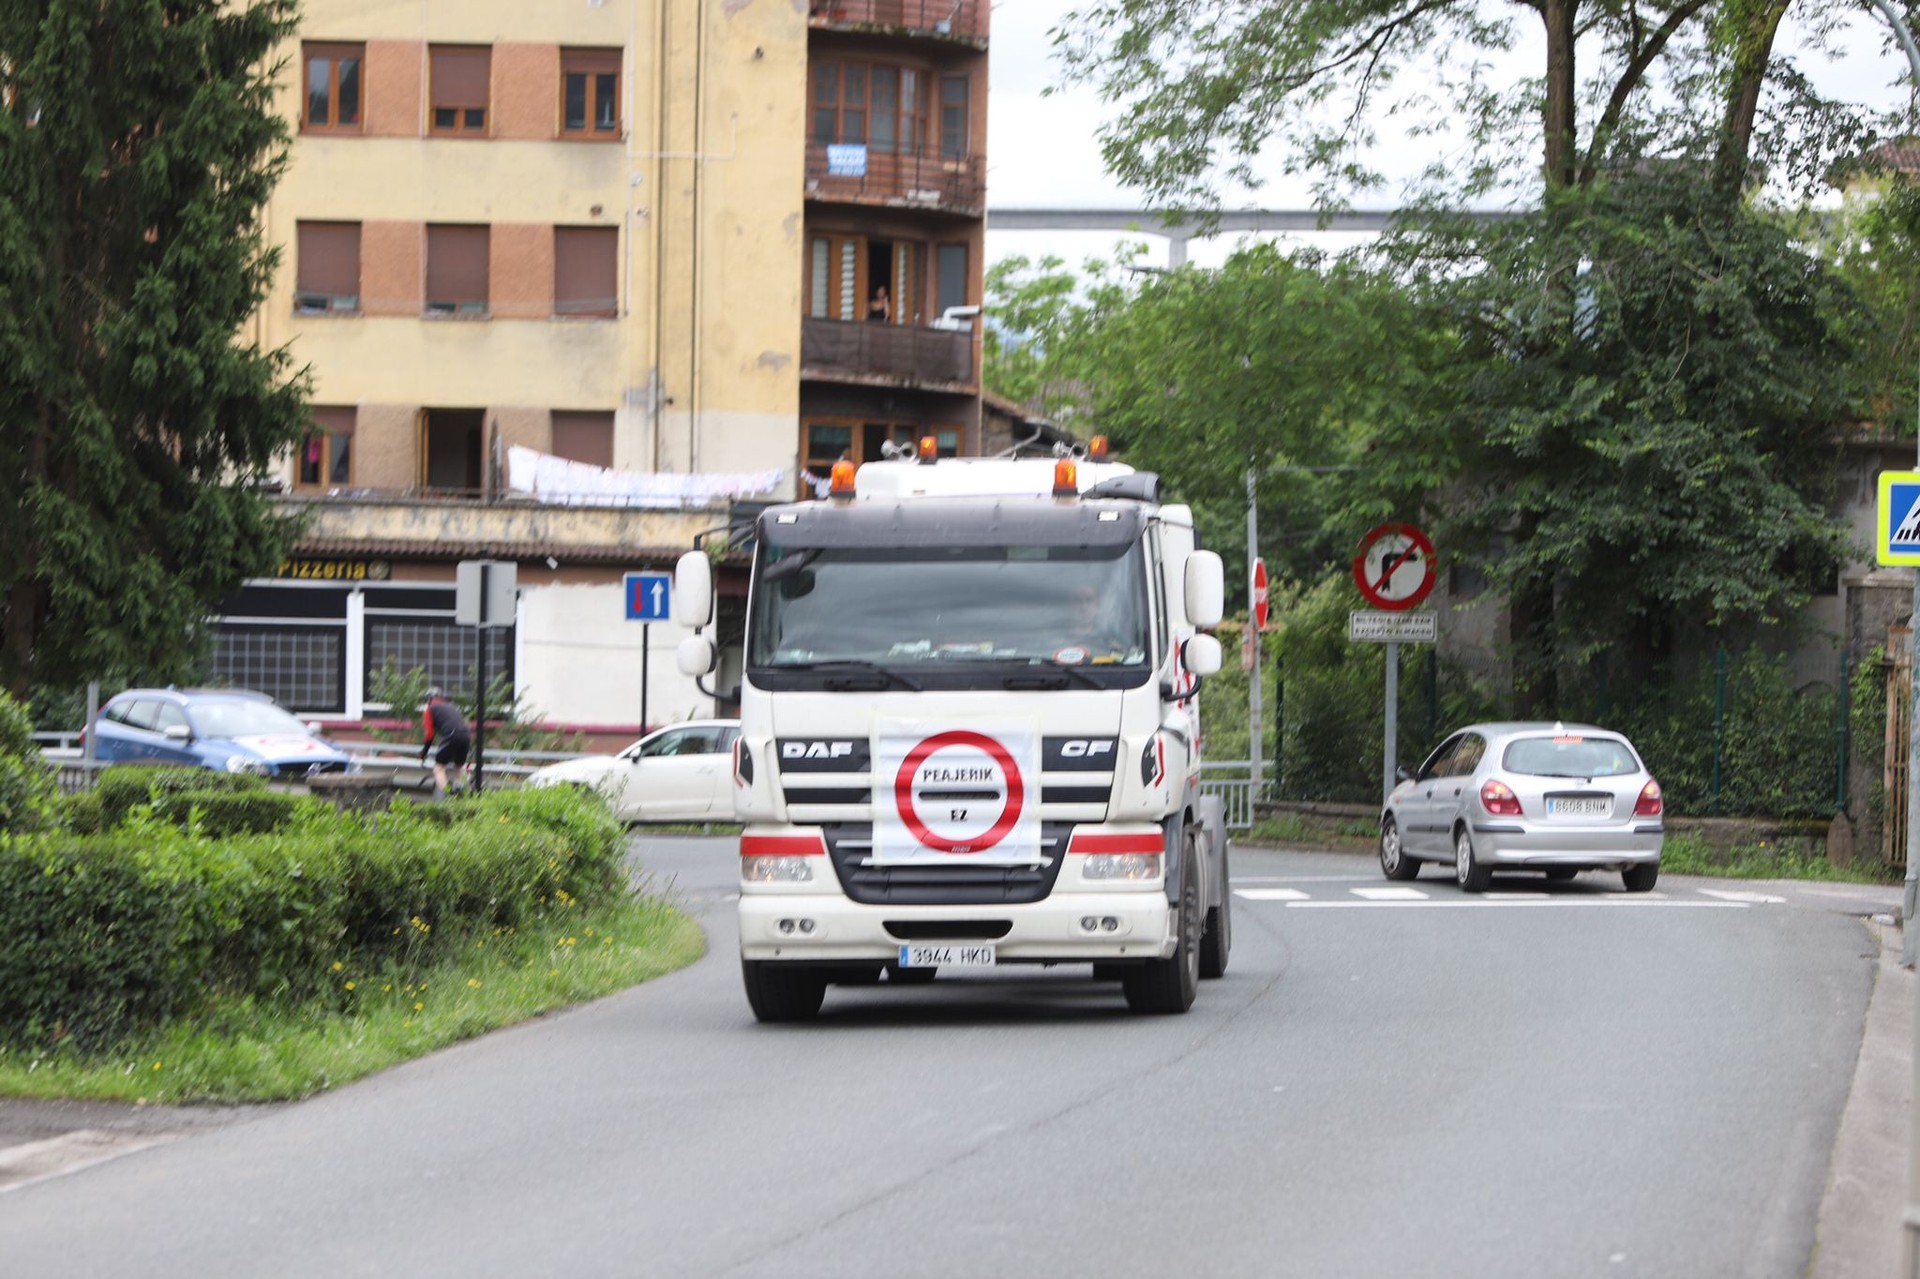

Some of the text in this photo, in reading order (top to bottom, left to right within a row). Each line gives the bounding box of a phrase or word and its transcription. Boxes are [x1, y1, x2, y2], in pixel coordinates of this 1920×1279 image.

[782, 741, 853, 759] DAF
[1061, 740, 1114, 757] CF
[923, 768, 994, 782] PEAJERIK
[951, 808, 968, 822] EZ
[913, 946, 991, 964] 3944 HKD
